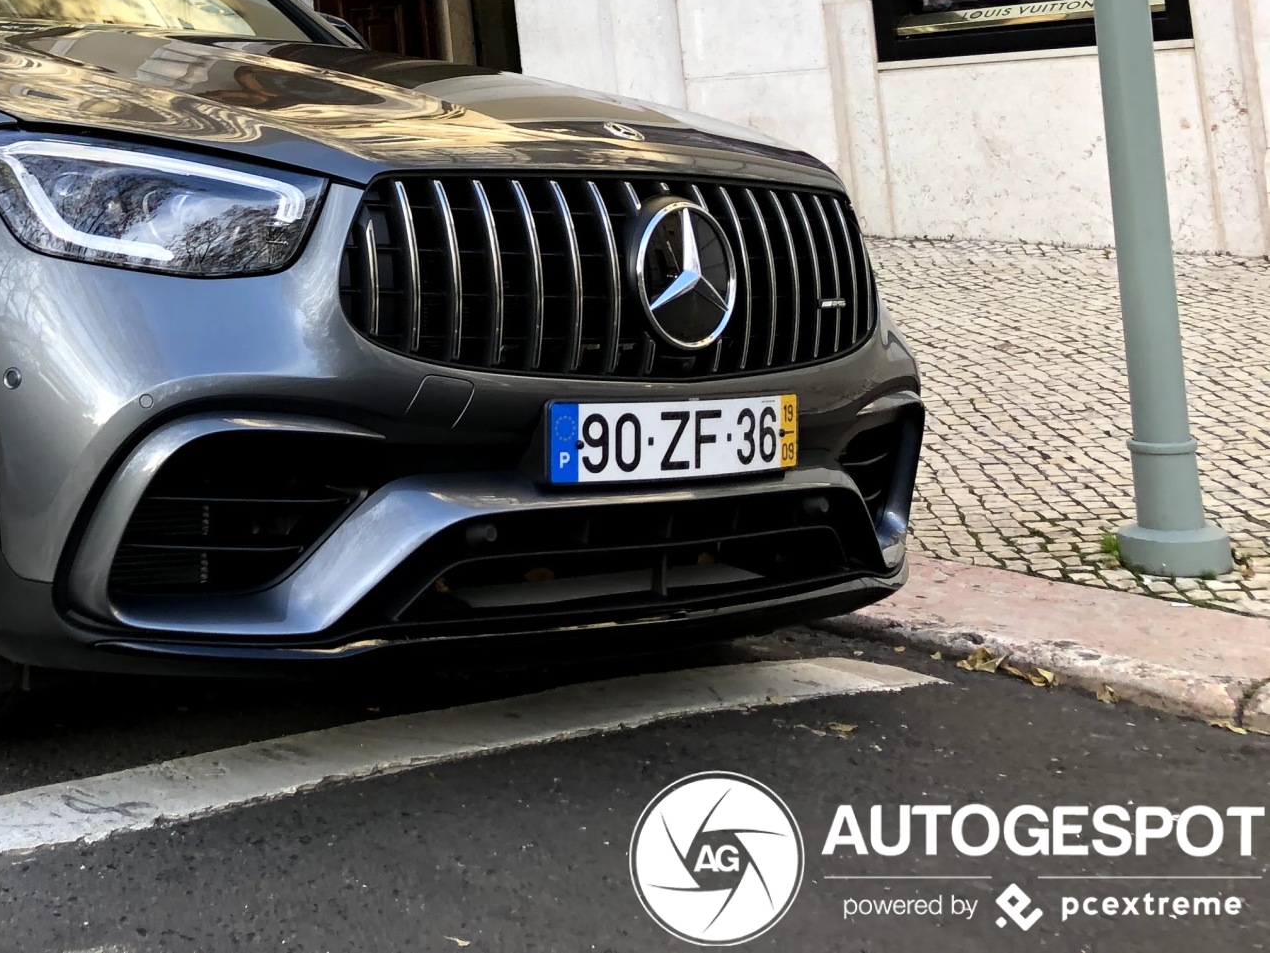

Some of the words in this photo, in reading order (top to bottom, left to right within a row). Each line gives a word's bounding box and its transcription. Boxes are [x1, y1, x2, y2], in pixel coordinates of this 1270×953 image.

[962, 7, 1012, 21] LOUIS
[1019, 0, 1094, 15] VUITTON
[783, 404, 793, 423] 19
[559, 451, 570, 468] P
[781, 442, 794, 461] 09
